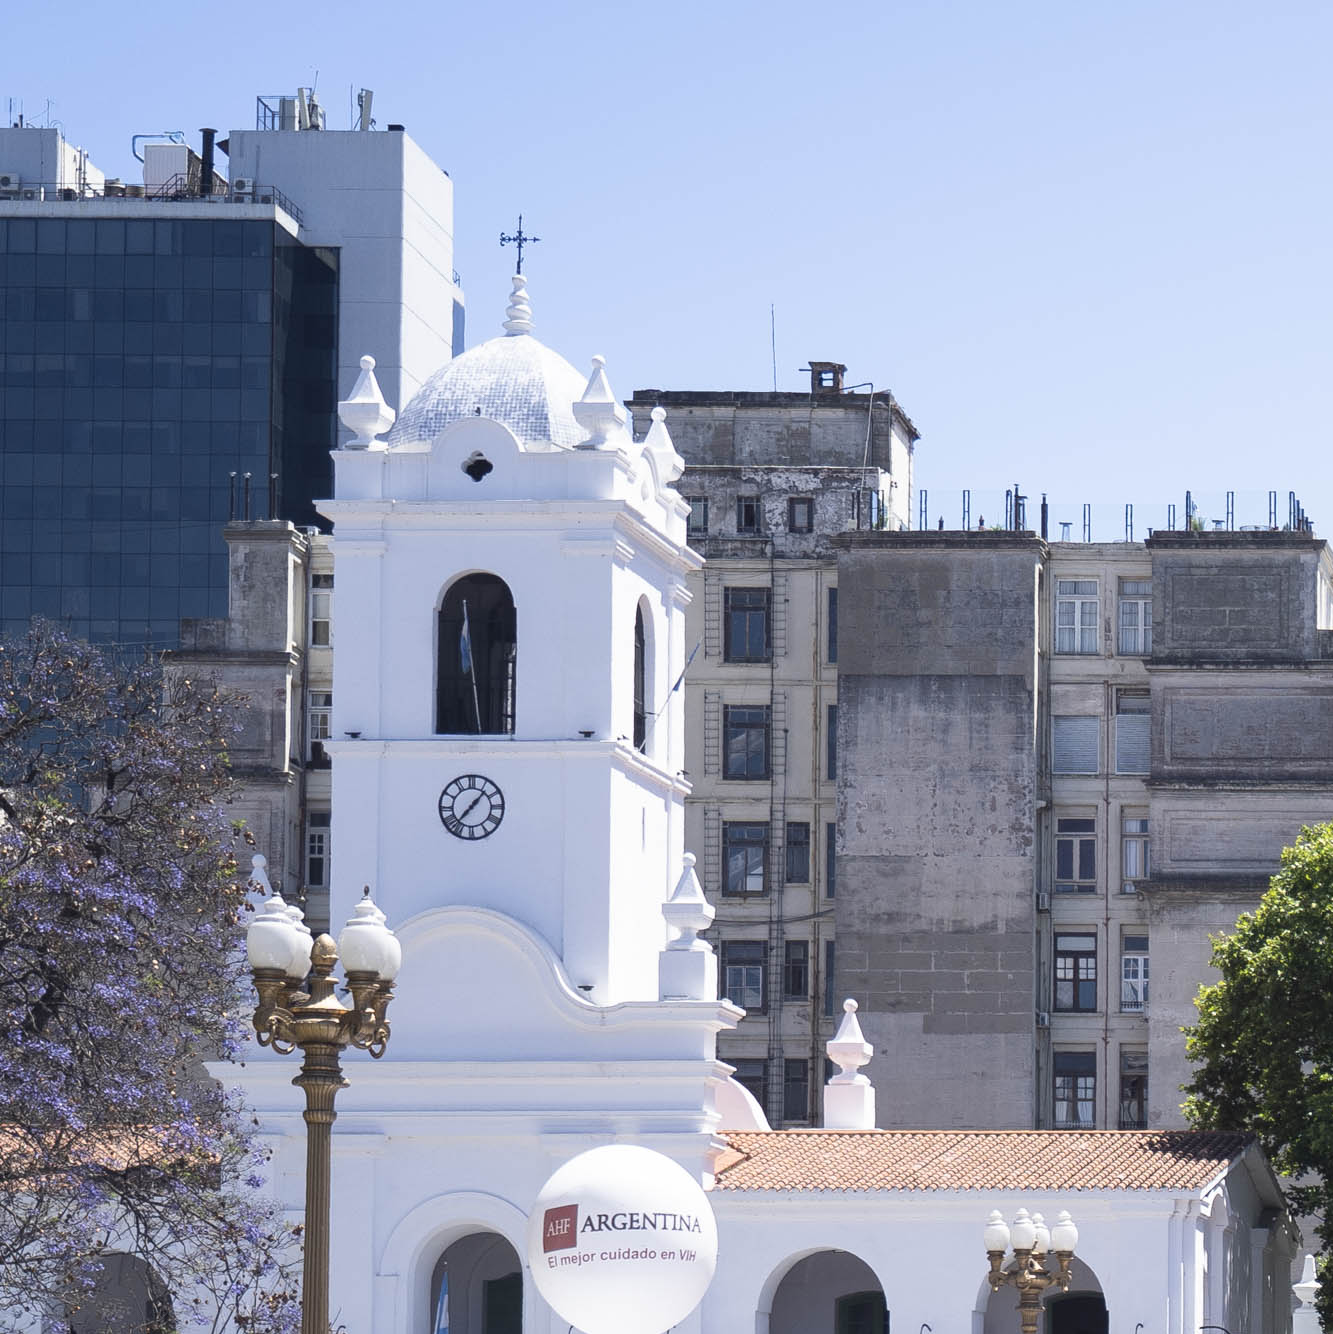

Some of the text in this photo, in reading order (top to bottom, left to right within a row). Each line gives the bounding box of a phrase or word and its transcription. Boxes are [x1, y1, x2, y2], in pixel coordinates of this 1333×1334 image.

[547, 1213, 702, 1237] AHF ARGENTINA
[547, 1247, 697, 1268] El mejor cuidado en VIH
